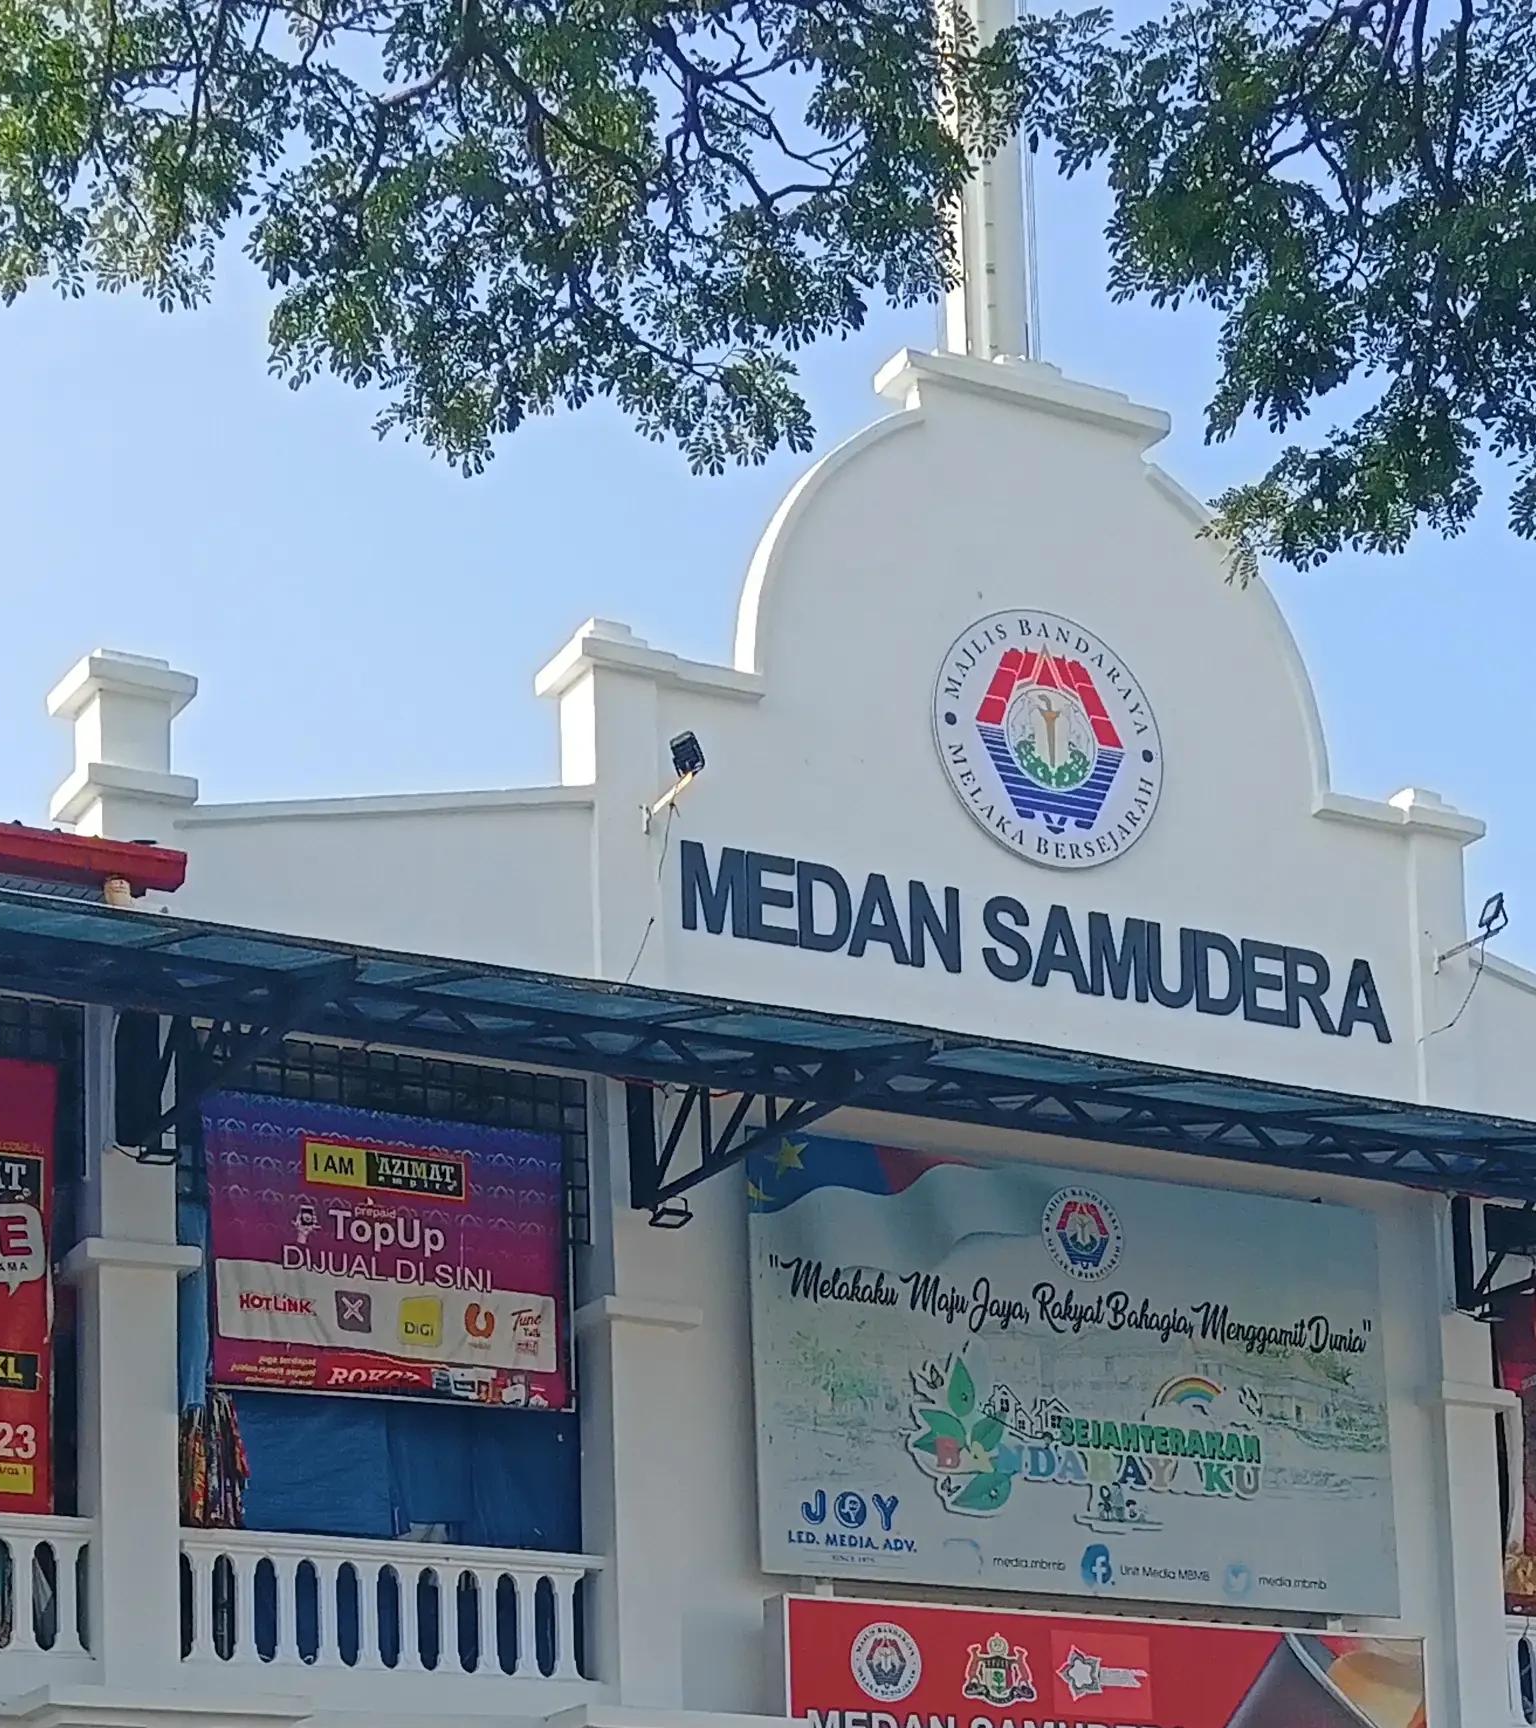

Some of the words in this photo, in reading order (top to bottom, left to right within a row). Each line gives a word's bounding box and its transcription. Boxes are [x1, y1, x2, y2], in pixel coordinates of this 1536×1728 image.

[944, 623, 1008, 699] MAJLIS
[1017, 619, 1149, 735] BANDARAYA
[948, 742, 1025, 845] MELAKA
[1036, 777, 1154, 860] BERSEJARAH
[680, 839, 961, 974] MEDAN
[981, 895, 1393, 1045] SAMUDERA
[324, 1155, 355, 1176] AM
[377, 1156, 456, 1183] AZIMAT
[328, 1208, 446, 1258] TopUp
[353, 1205, 397, 1220] prepaid
[282, 1245, 389, 1282] DIJUAL
[395, 1259, 426, 1285] DI
[434, 1263, 493, 1294] SINI
[899, 1271, 969, 1324] Maju
[968, 1276, 1031, 1333] Jaya,
[1032, 1282, 1106, 1334] Rakyat
[1106, 1290, 1194, 1343] Bahagia,
[1191, 1302, 1307, 1354] Menggamit
[1061, 1415, 1262, 1465] SEJAHTERAKAN
[801, 1488, 900, 1532] JOY
[1142, 1566, 1177, 1581] Media
